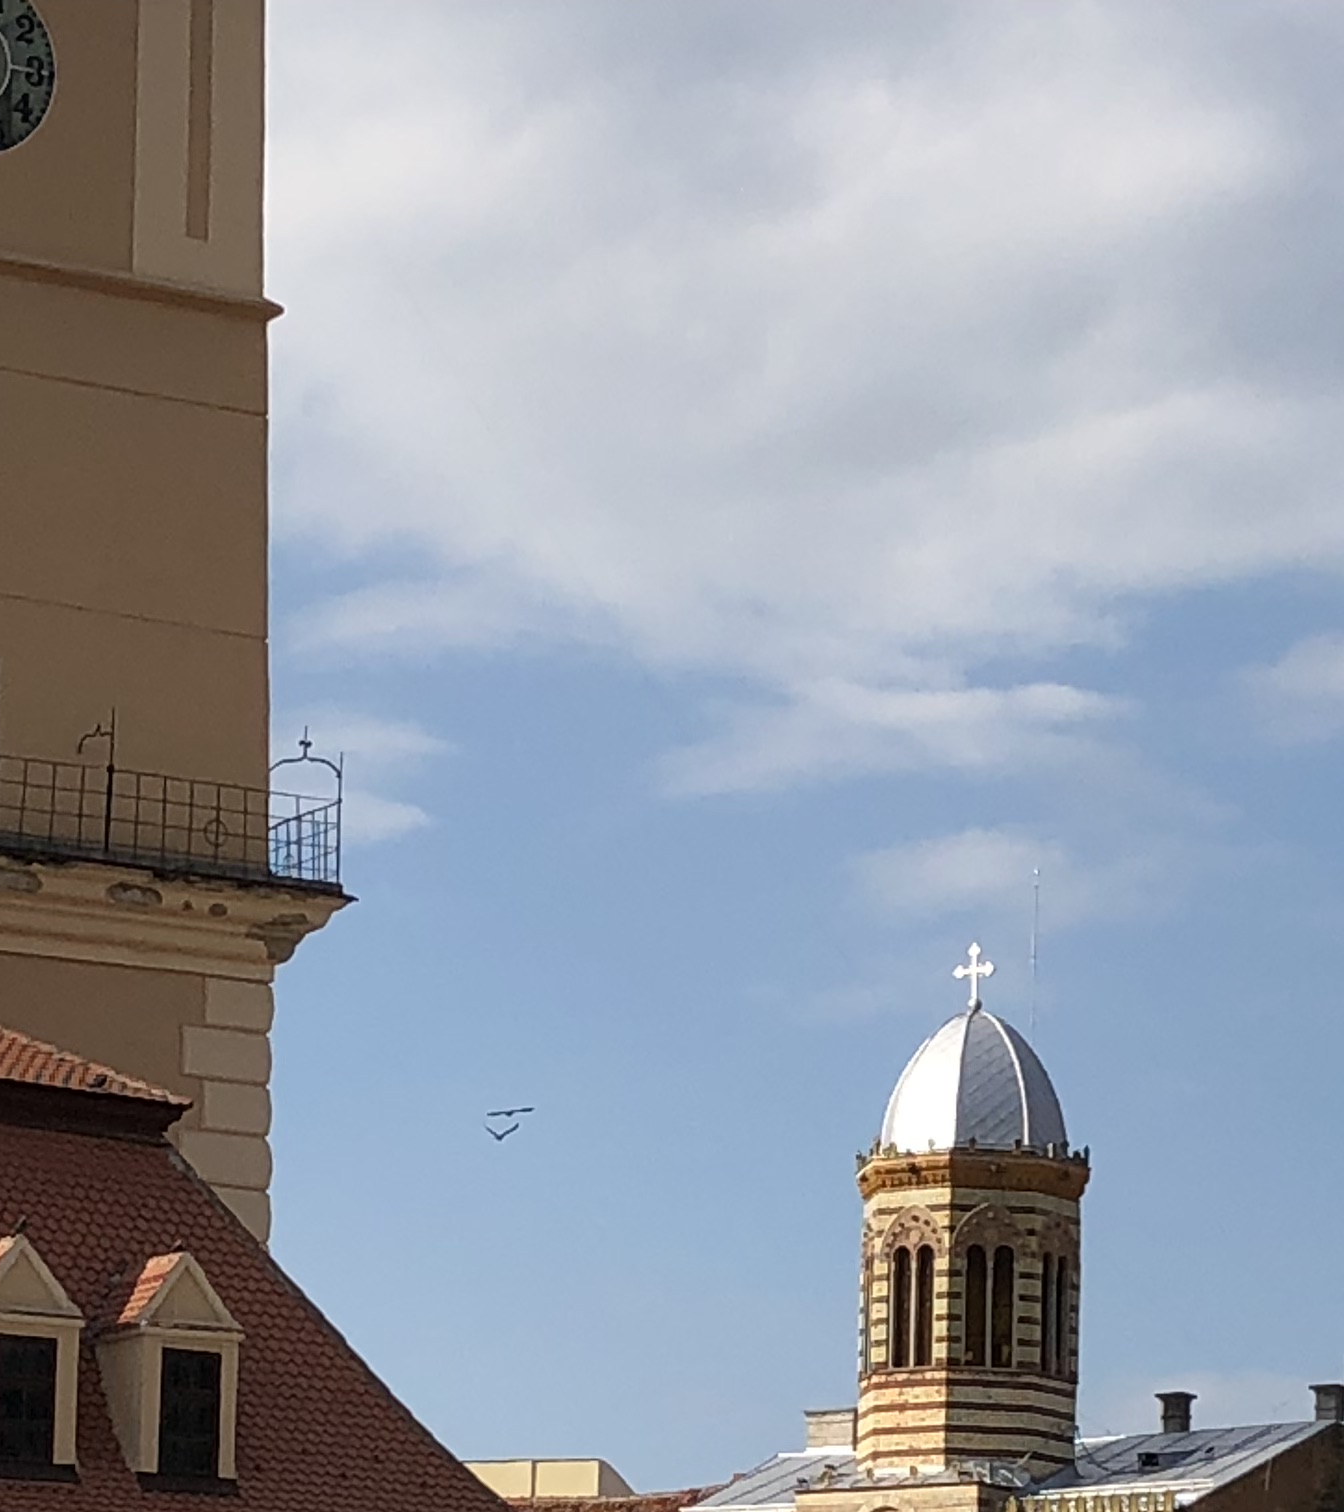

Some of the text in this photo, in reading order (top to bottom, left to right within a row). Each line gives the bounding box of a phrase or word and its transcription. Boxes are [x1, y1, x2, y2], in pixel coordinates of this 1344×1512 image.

[15, 14, 34, 44] 2
[24, 56, 44, 87] 3
[13, 93, 32, 123] 4
